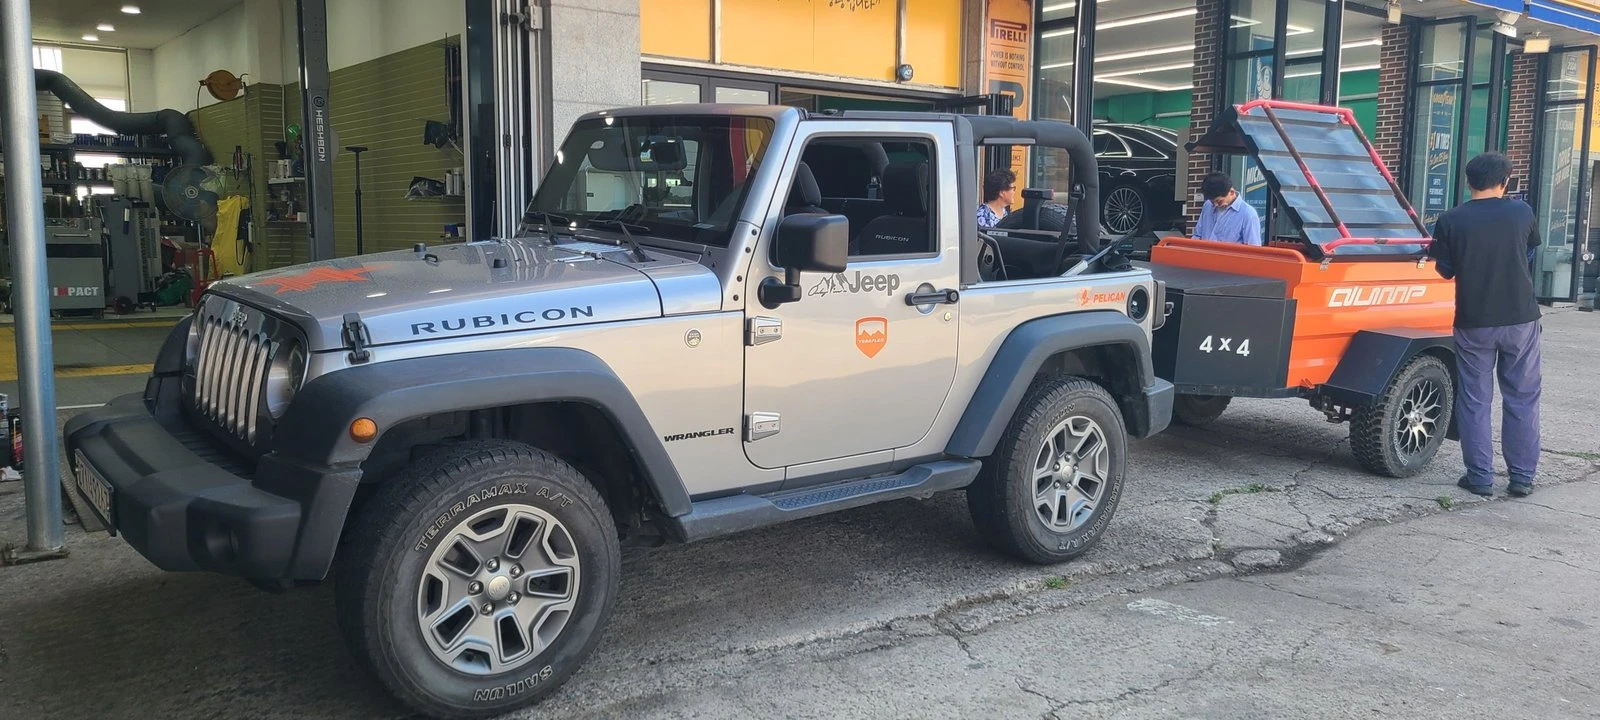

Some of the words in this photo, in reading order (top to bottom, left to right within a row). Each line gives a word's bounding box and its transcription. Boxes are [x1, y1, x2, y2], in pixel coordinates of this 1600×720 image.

[990, 18, 1027, 43] PIRELLI
[315, 109, 326, 162] HESHBON
[875, 234, 909, 242] RUBICON
[53, 286, 99, 297] IMPACT
[848, 270, 900, 297] Jeep
[1093, 291, 1126, 303] PELICAN
[410, 305, 594, 335] RUBICON
[1199, 335, 1212, 353] 4
[1236, 338, 1250, 357] 4
[663, 427, 735, 442] WRANGLER
[415, 482, 528, 551] TERRAMAX
[536, 486, 574, 508] A/T
[472, 664, 553, 701] SAILUN
